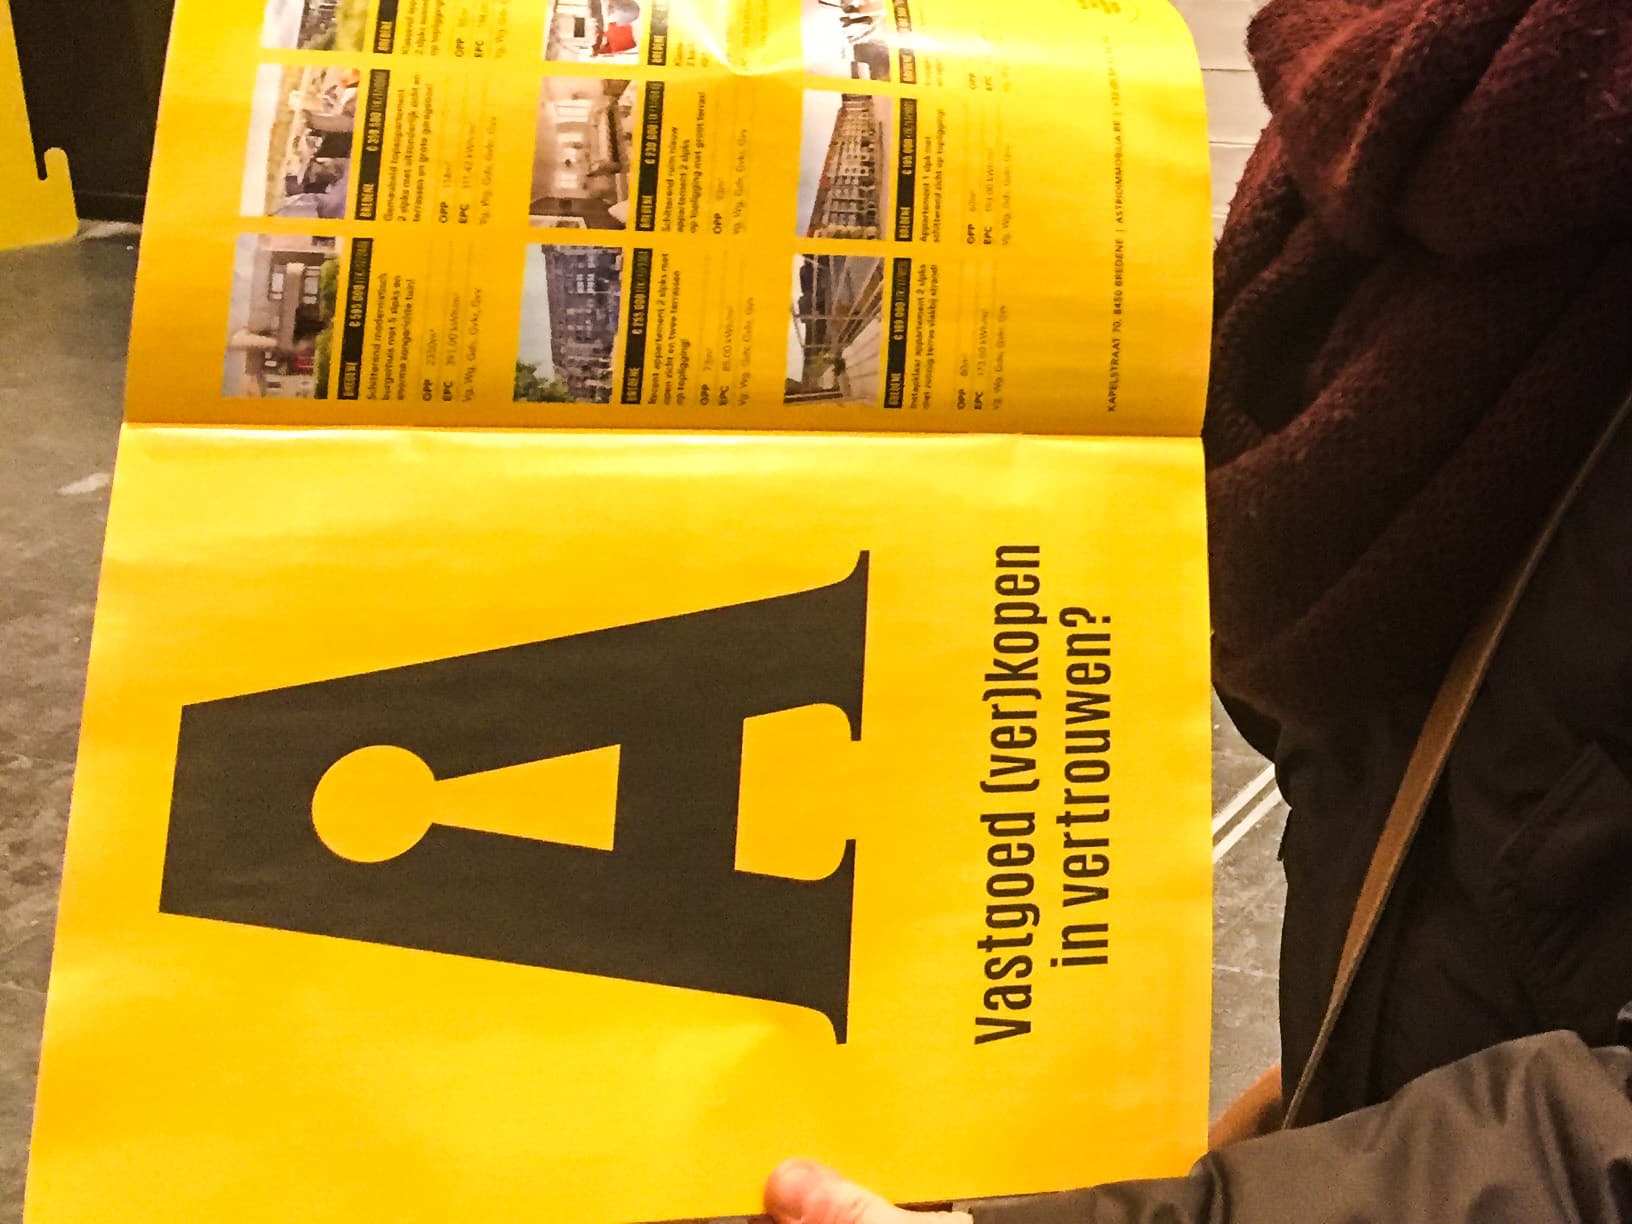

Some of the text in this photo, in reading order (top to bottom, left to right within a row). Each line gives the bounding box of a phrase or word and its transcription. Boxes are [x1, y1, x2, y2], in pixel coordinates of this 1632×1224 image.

[440, 200, 449, 223] OPP
[458, 203, 469, 223] EPC
[713, 212, 723, 233] OPP
[967, 223, 975, 243] OPP
[983, 225, 992, 244] EPC
[1114, 238, 1125, 286] BREDENE
[1112, 289, 1122, 314] 8450
[1107, 337, 1121, 411] KAPELSTRAAT
[422, 378, 432, 400] OPP
[442, 380, 453, 400] EPC
[700, 383, 710, 405] OPP
[719, 384, 730, 405] EPC
[957, 388, 966, 409] OPP
[974, 390, 984, 409] EPC
[974, 544, 1048, 1044] Vastgoed (ver)kopen
[1050, 606, 1111, 966] in vertrouwen?
